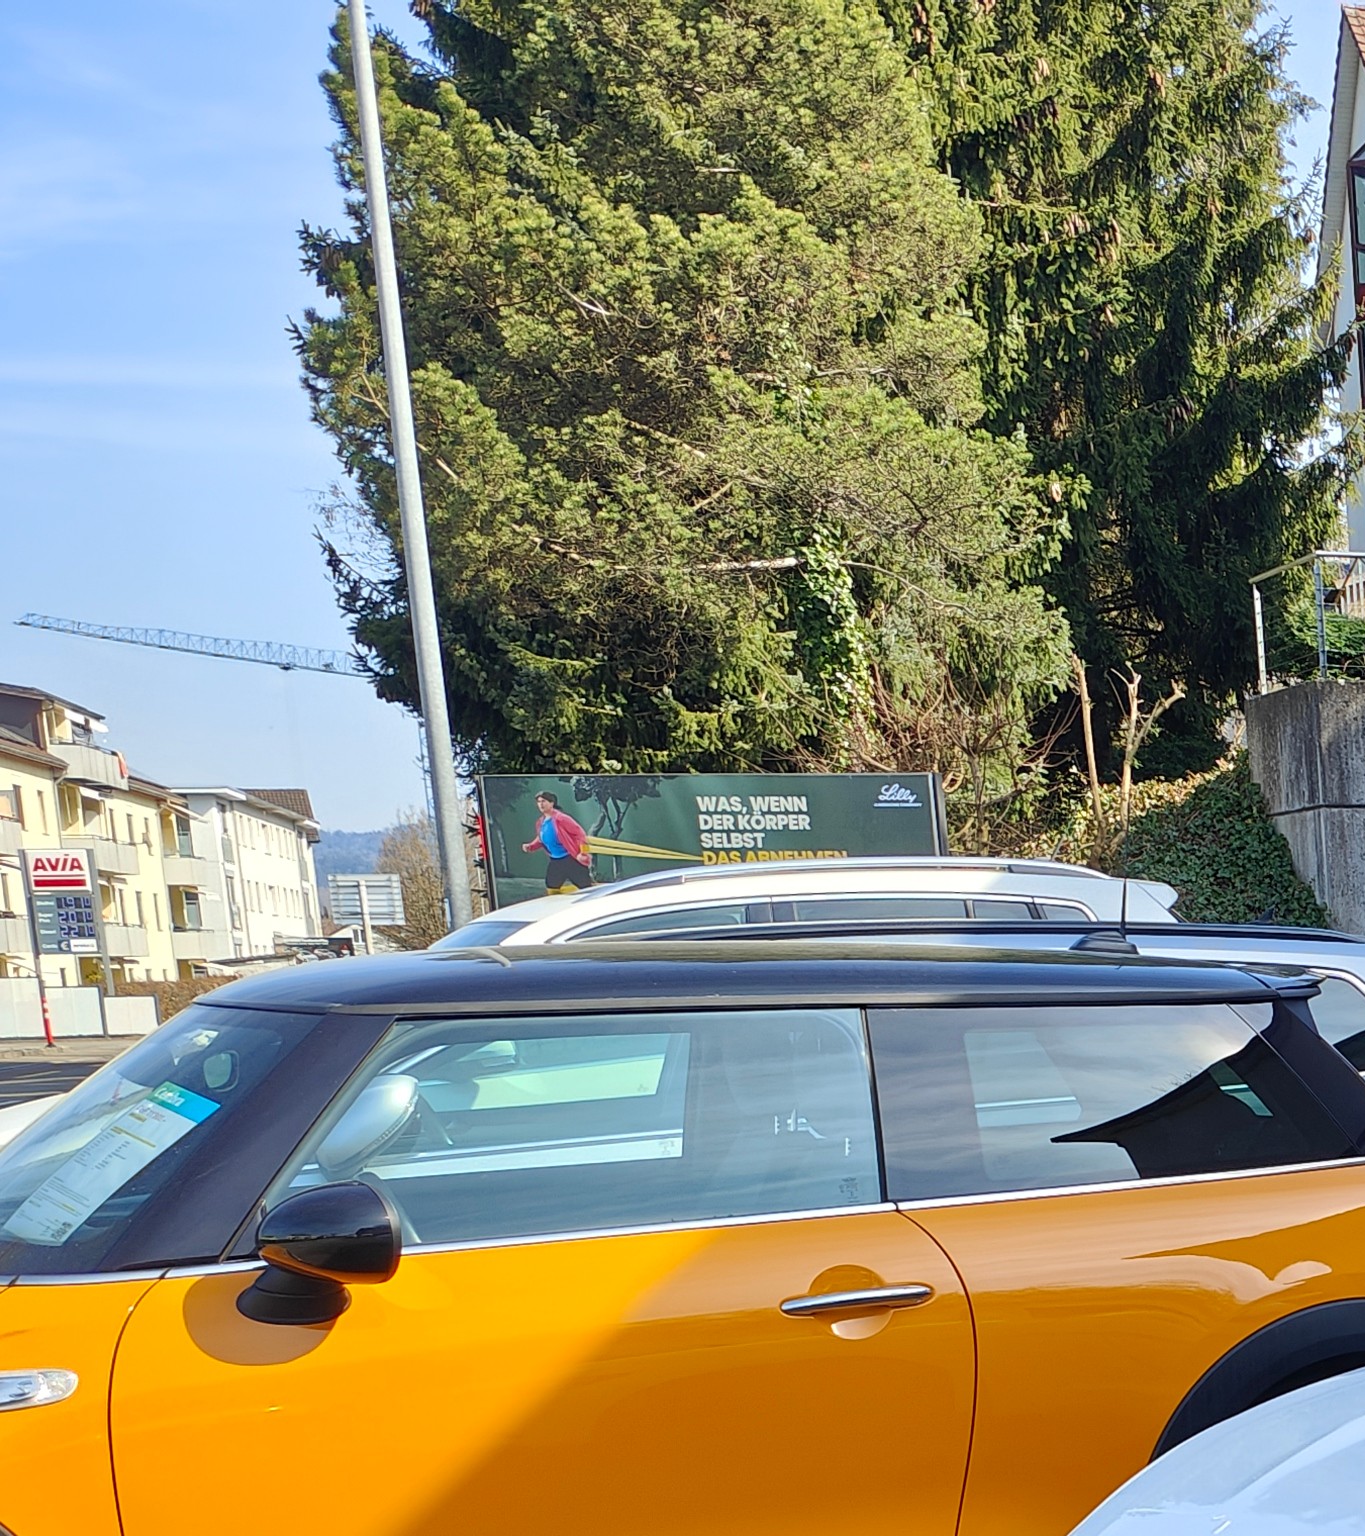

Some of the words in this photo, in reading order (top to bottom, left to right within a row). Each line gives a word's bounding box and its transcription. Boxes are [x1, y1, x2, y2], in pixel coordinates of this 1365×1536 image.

[878, 783, 917, 803] Lilly
[696, 796, 747, 814] WAS,
[749, 796, 808, 812] WENN
[698, 814, 735, 830] DER
[738, 809, 811, 830] KÖRPER
[701, 832, 765, 848] SELBST
[702, 851, 742, 866] DAS
